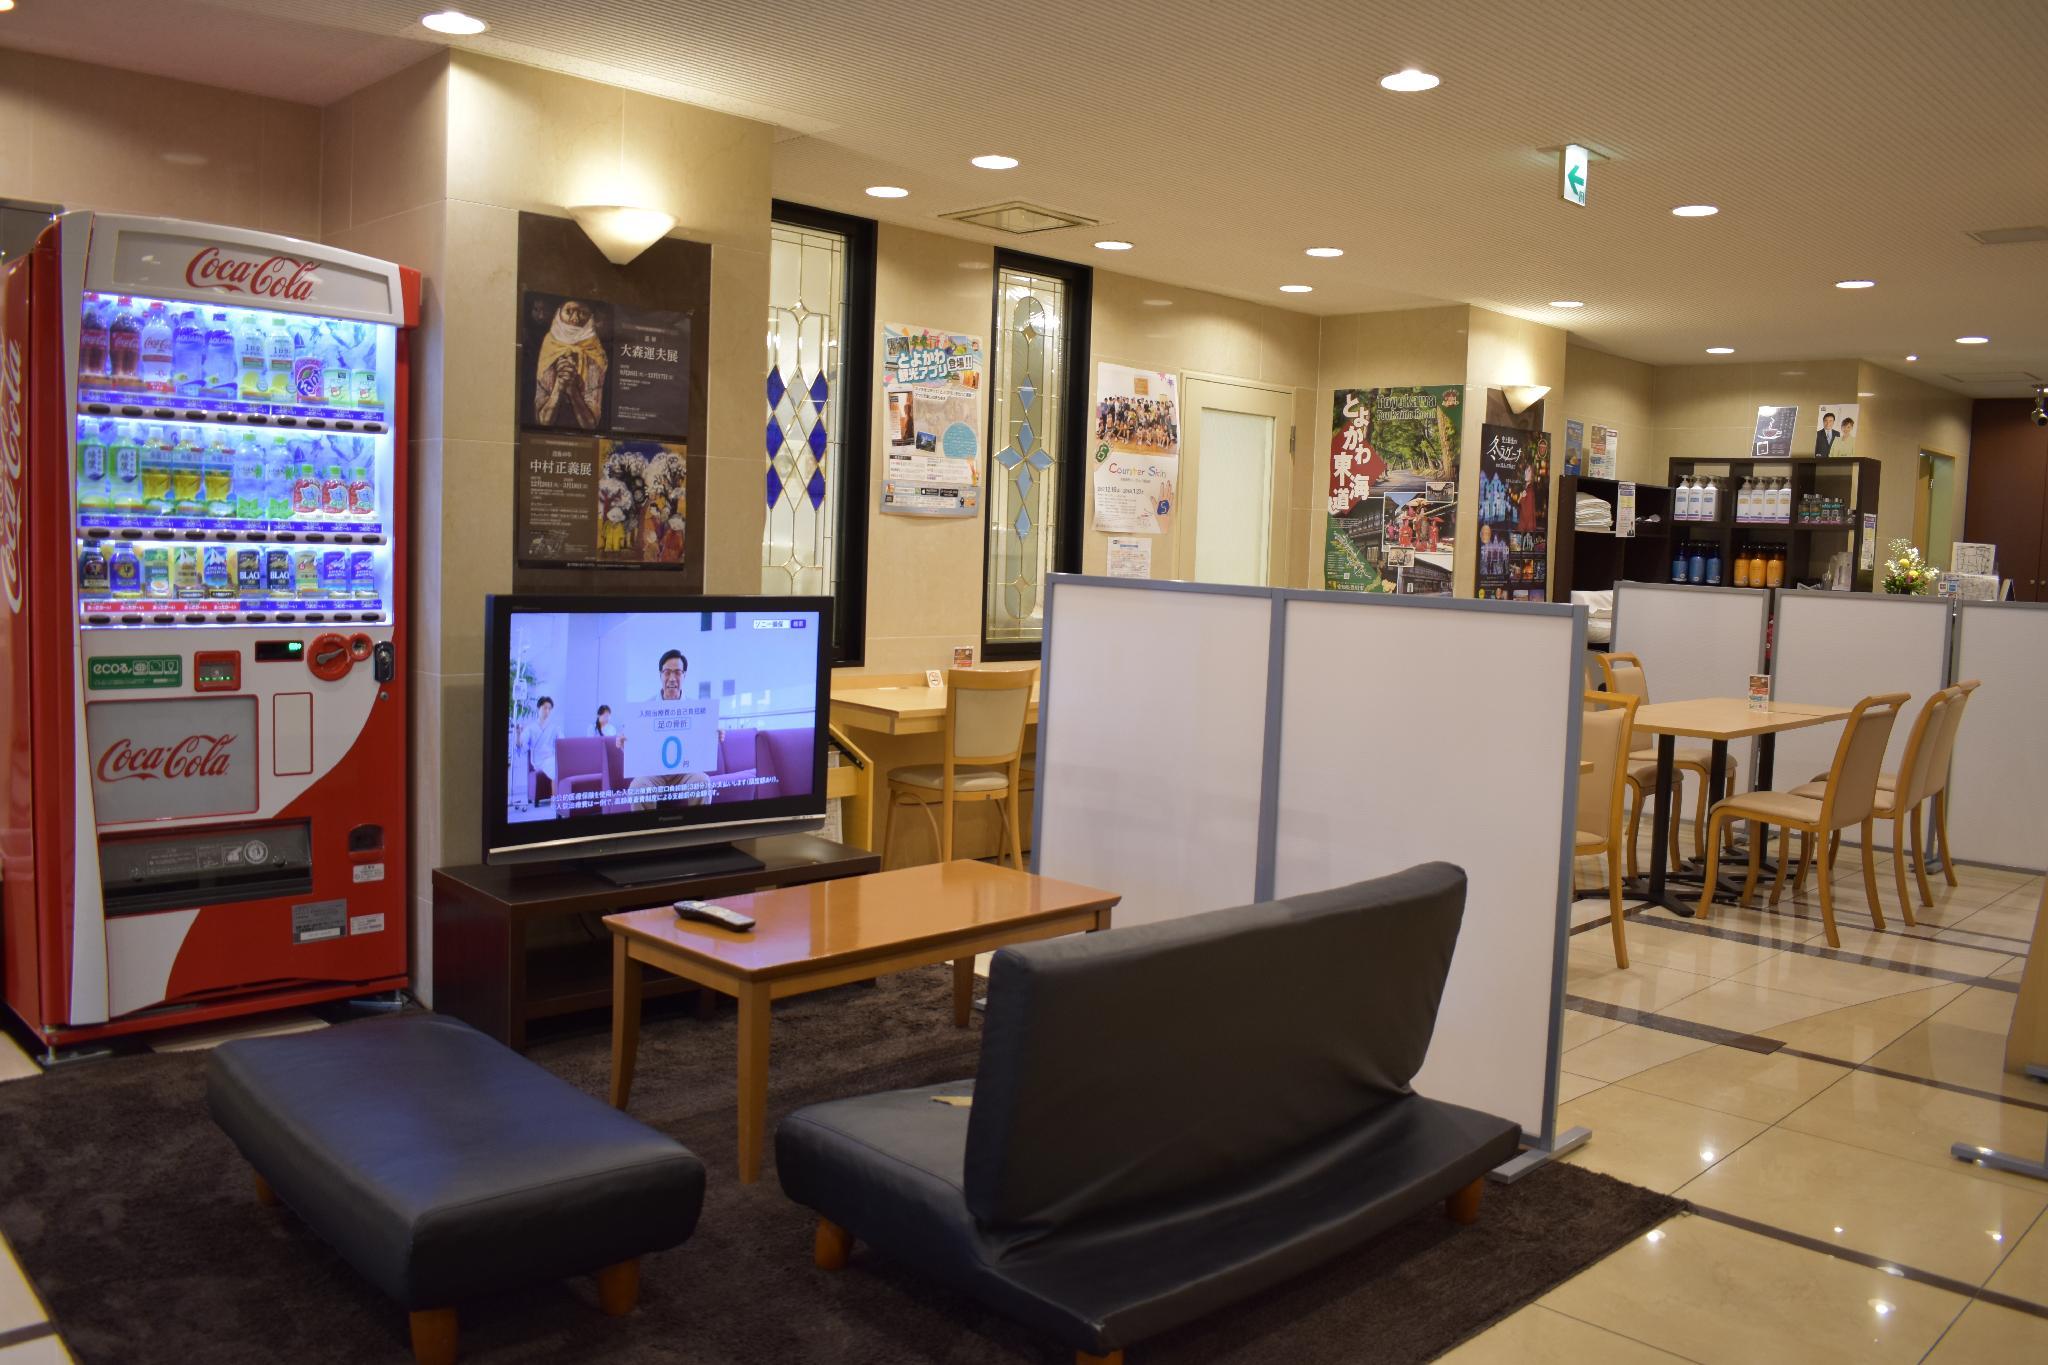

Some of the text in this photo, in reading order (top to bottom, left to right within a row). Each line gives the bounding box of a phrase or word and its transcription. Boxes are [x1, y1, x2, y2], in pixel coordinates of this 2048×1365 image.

[186, 247, 321, 300] Coca-Cola
[620, 344, 679, 363] 大森運夫展
[898, 349, 946, 368] とよかわ
[530, 459, 593, 476] 中村正義展
[1108, 462, 1145, 476] Counter
[97, 734, 238, 783] Coca-Cola
